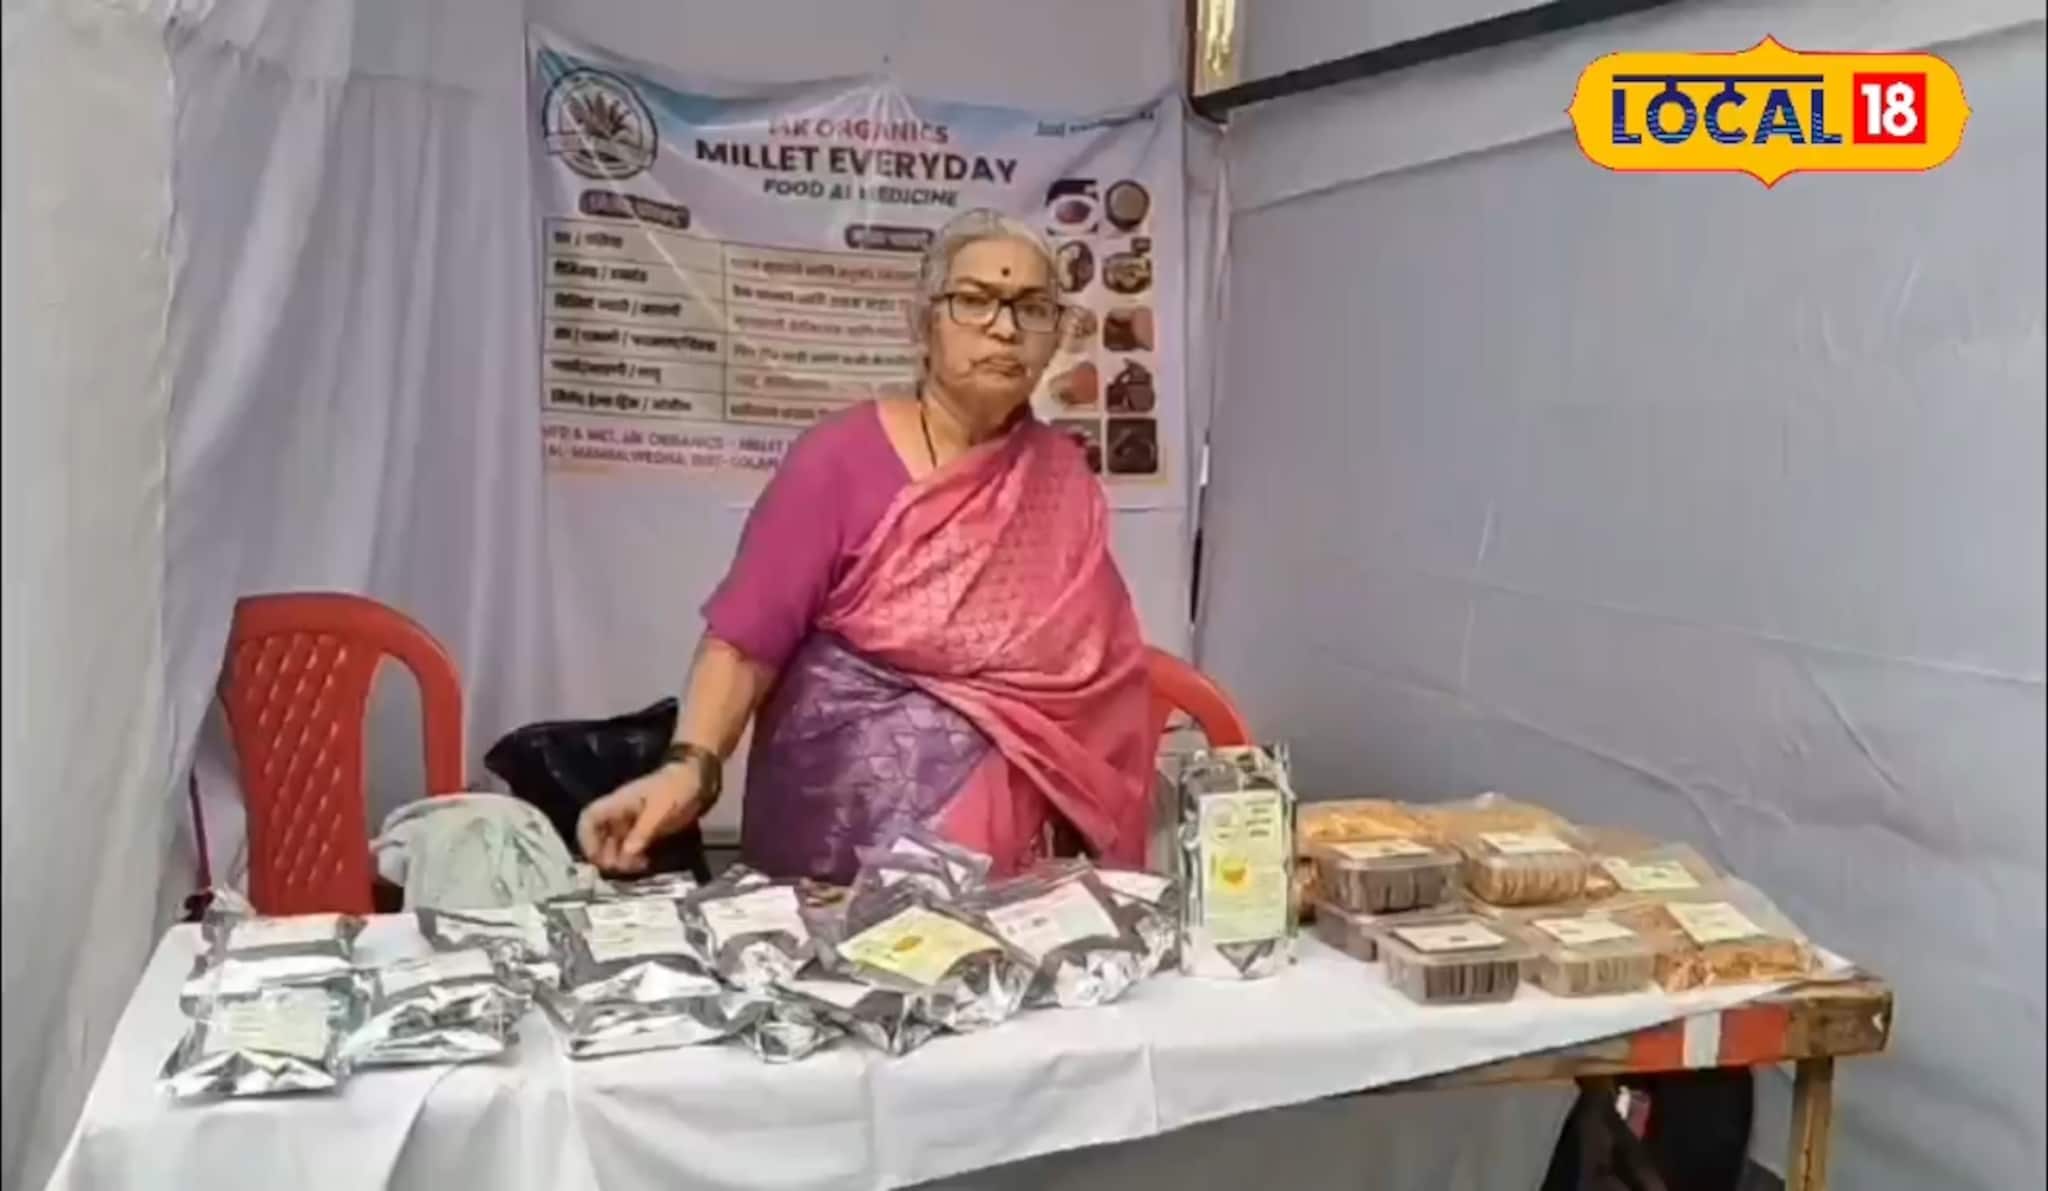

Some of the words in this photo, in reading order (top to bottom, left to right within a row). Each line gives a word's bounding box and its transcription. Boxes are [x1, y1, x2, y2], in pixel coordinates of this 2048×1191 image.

[815, 119, 949, 144] ORGANICS
[696, 139, 819, 173] MILLET
[829, 147, 1018, 183] EVERYDAY
[763, 178, 824, 199] FOOD
